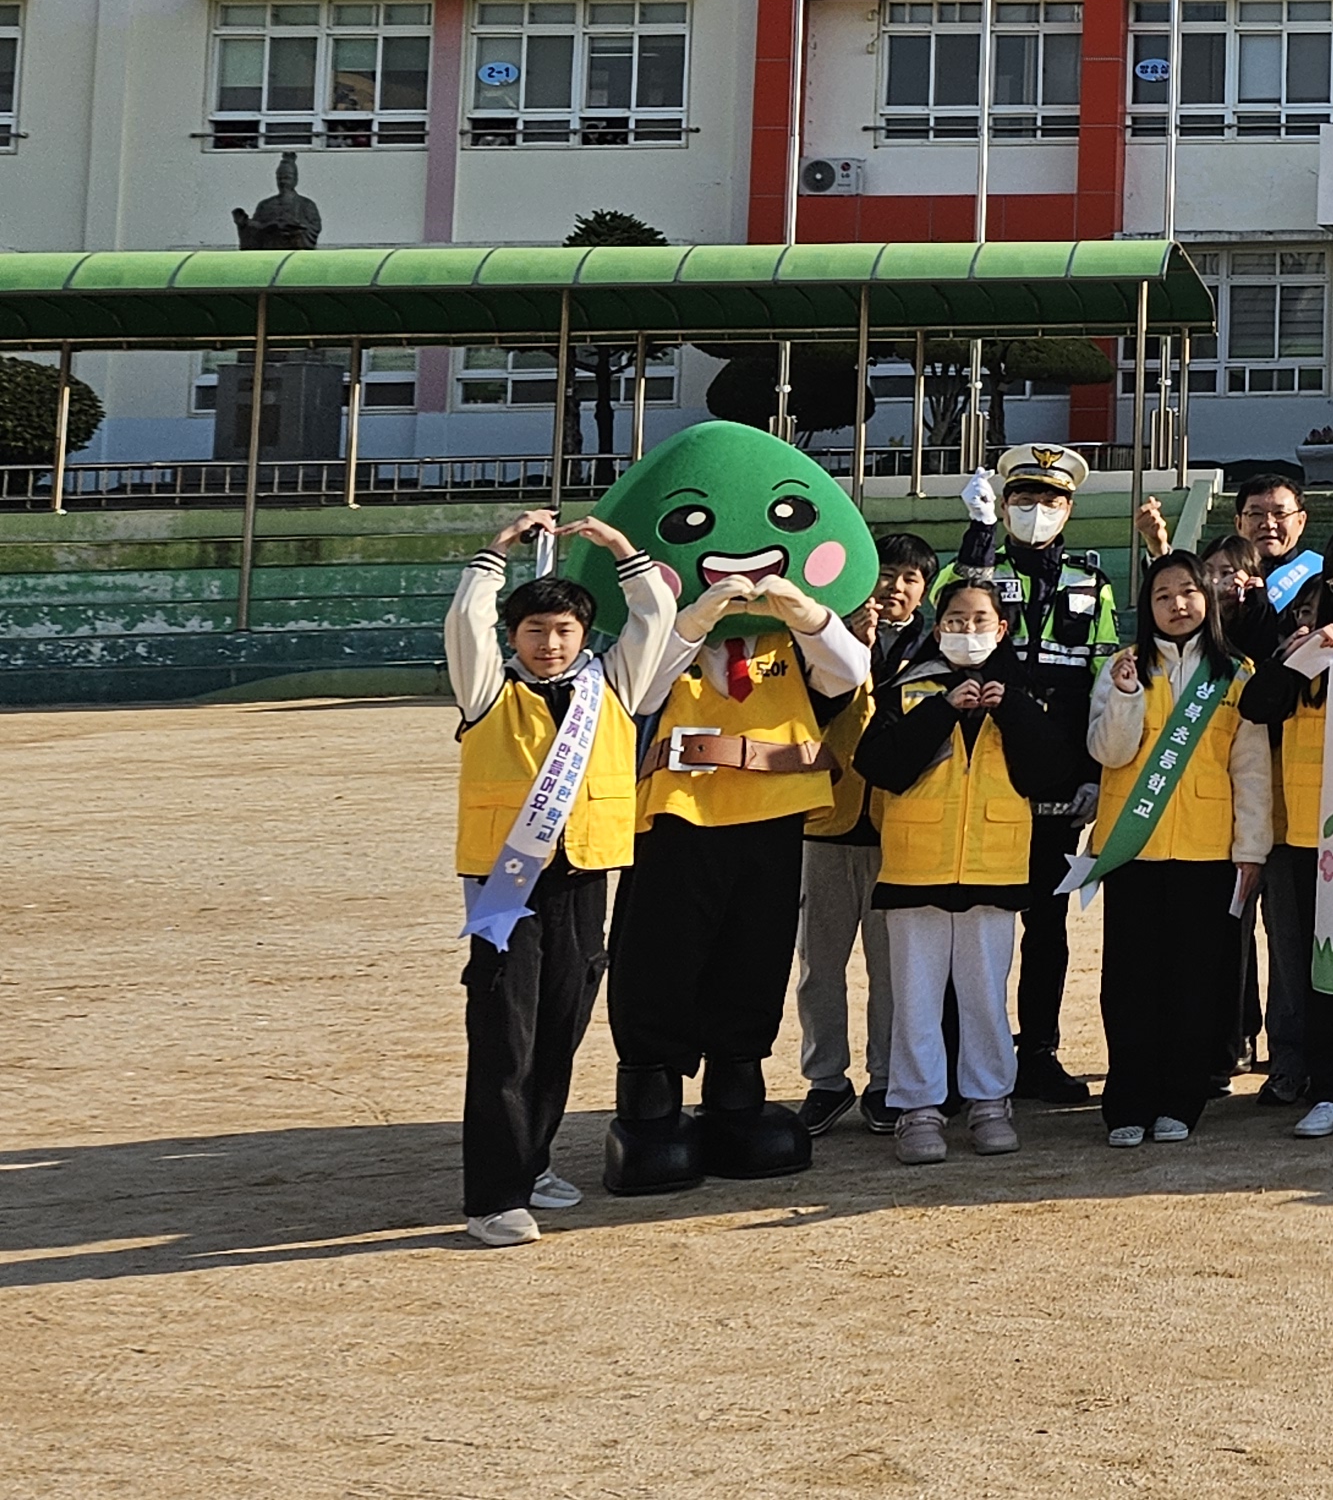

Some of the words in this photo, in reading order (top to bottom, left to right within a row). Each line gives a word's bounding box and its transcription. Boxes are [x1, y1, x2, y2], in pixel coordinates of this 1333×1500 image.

[487, 67, 510, 78] 2-1
[1133, 681, 1216, 819] 상북초등학교
[526, 742, 572, 827] 만들어요!
[555, 752, 584, 803] 행복한
[535, 806, 563, 844] 학교
